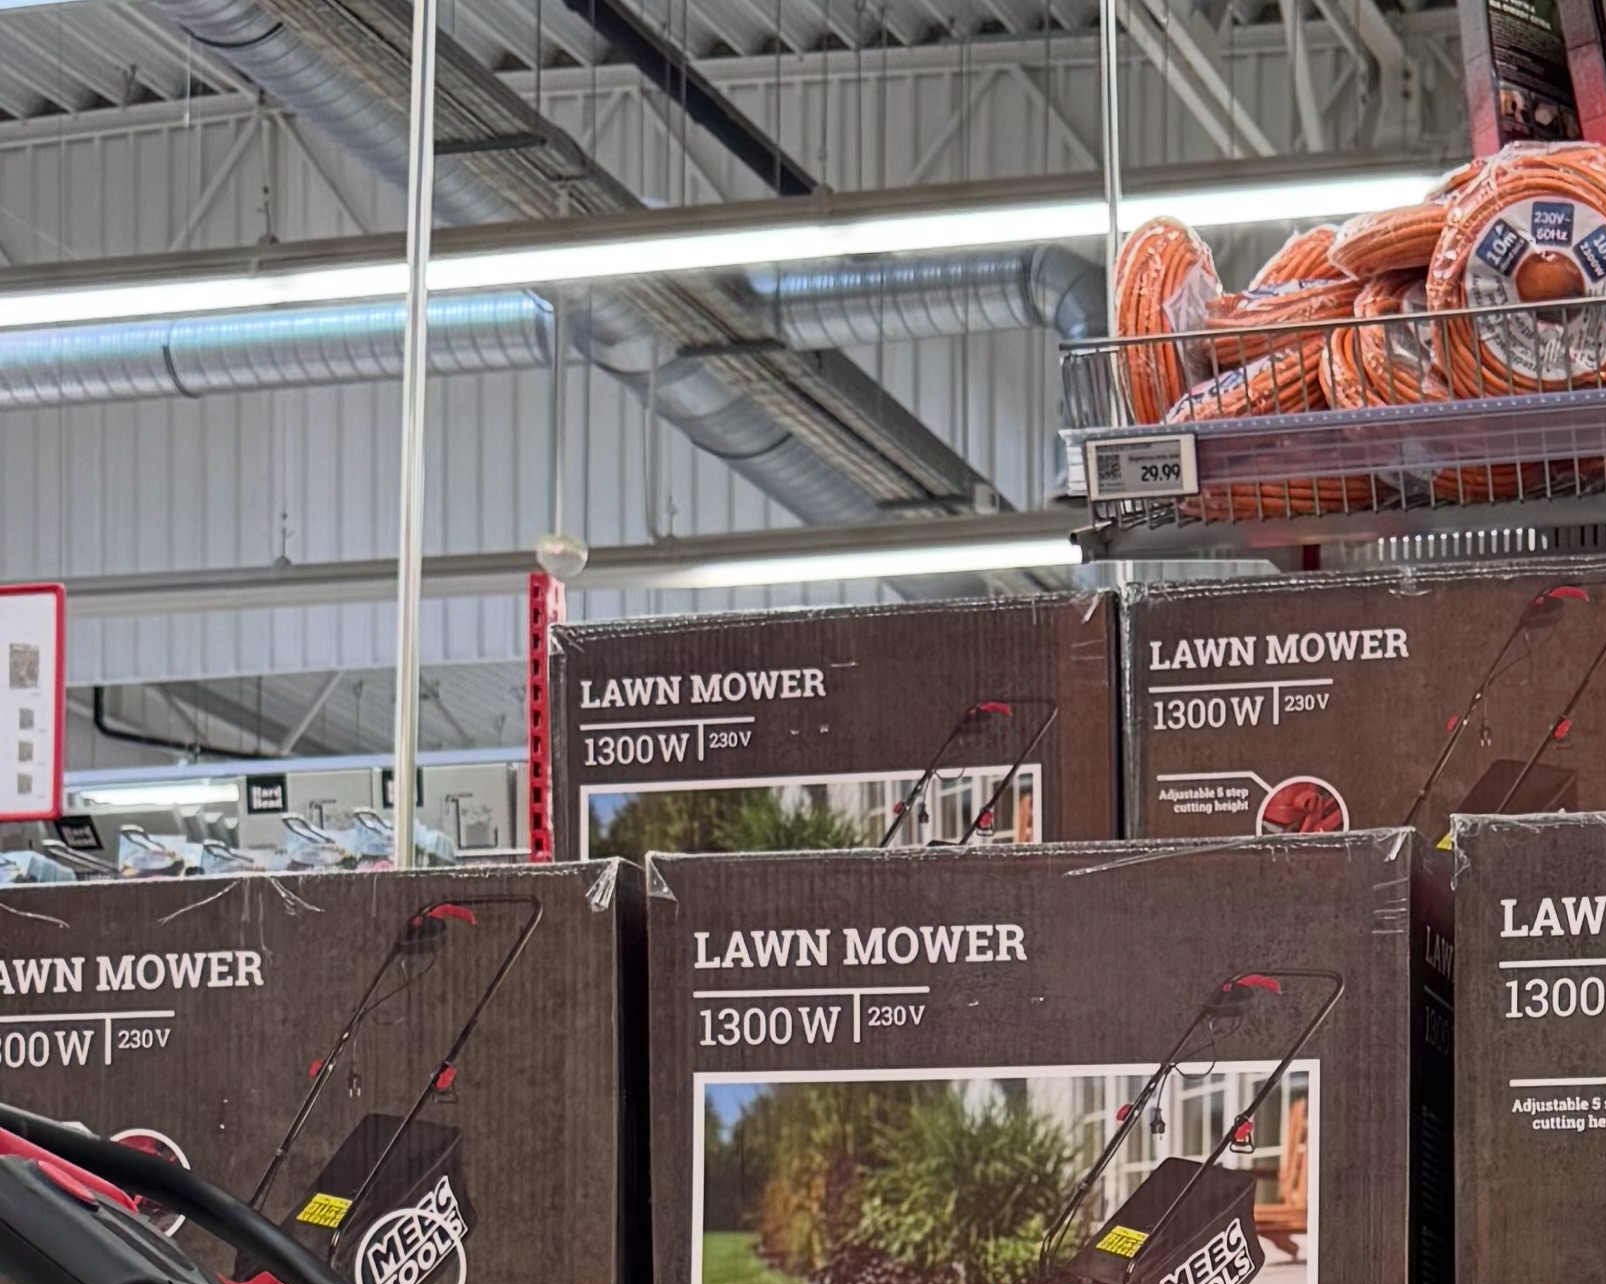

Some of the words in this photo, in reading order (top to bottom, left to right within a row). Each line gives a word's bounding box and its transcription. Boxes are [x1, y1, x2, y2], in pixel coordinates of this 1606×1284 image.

[1141, 464, 1181, 482] 29.99
[1149, 636, 1257, 671] LAWN
[1265, 628, 1410, 665] MOWER
[580, 675, 682, 709] LAWN
[690, 668, 826, 703] MOWER
[693, 928, 831, 969] LAWN
[842, 923, 1028, 965] MOWER
[0, 956, 86, 995] AWN
[95, 950, 265, 992] MOWER
[1511, 1096, 1590, 1116] Adjustable
[1591, 1096, 1601, 1111] 5
[1533, 1115, 1587, 1132] cutting
